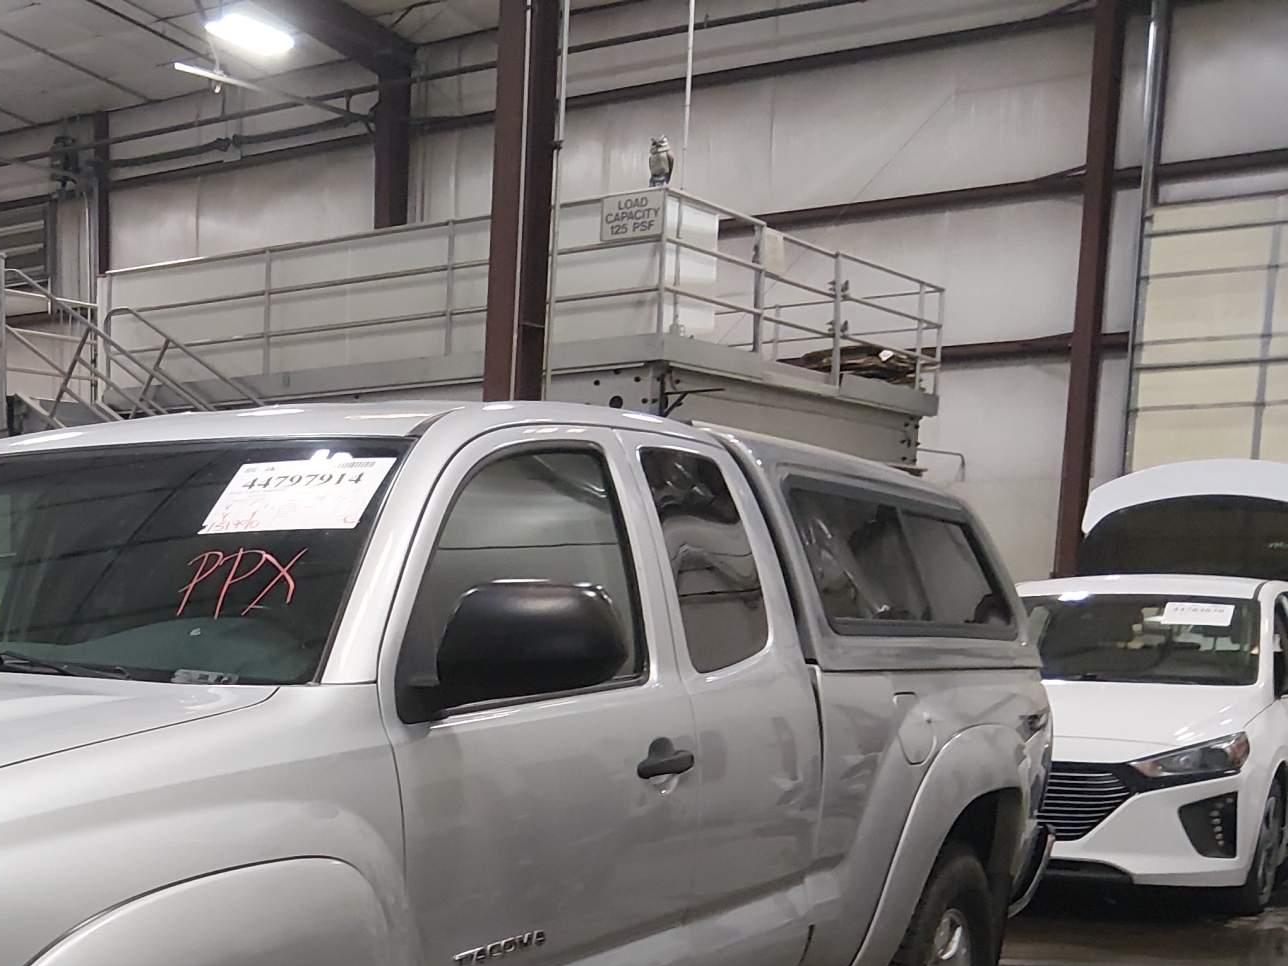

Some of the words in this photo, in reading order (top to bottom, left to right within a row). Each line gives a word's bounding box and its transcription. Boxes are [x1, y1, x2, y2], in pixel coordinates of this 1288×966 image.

[618, 196, 648, 210] LOAD
[605, 207, 660, 224] CAPACITY
[611, 223, 628, 235] 125
[632, 219, 655, 232] PSF
[242, 471, 365, 491] 44797914
[177, 547, 309, 620] PPX
